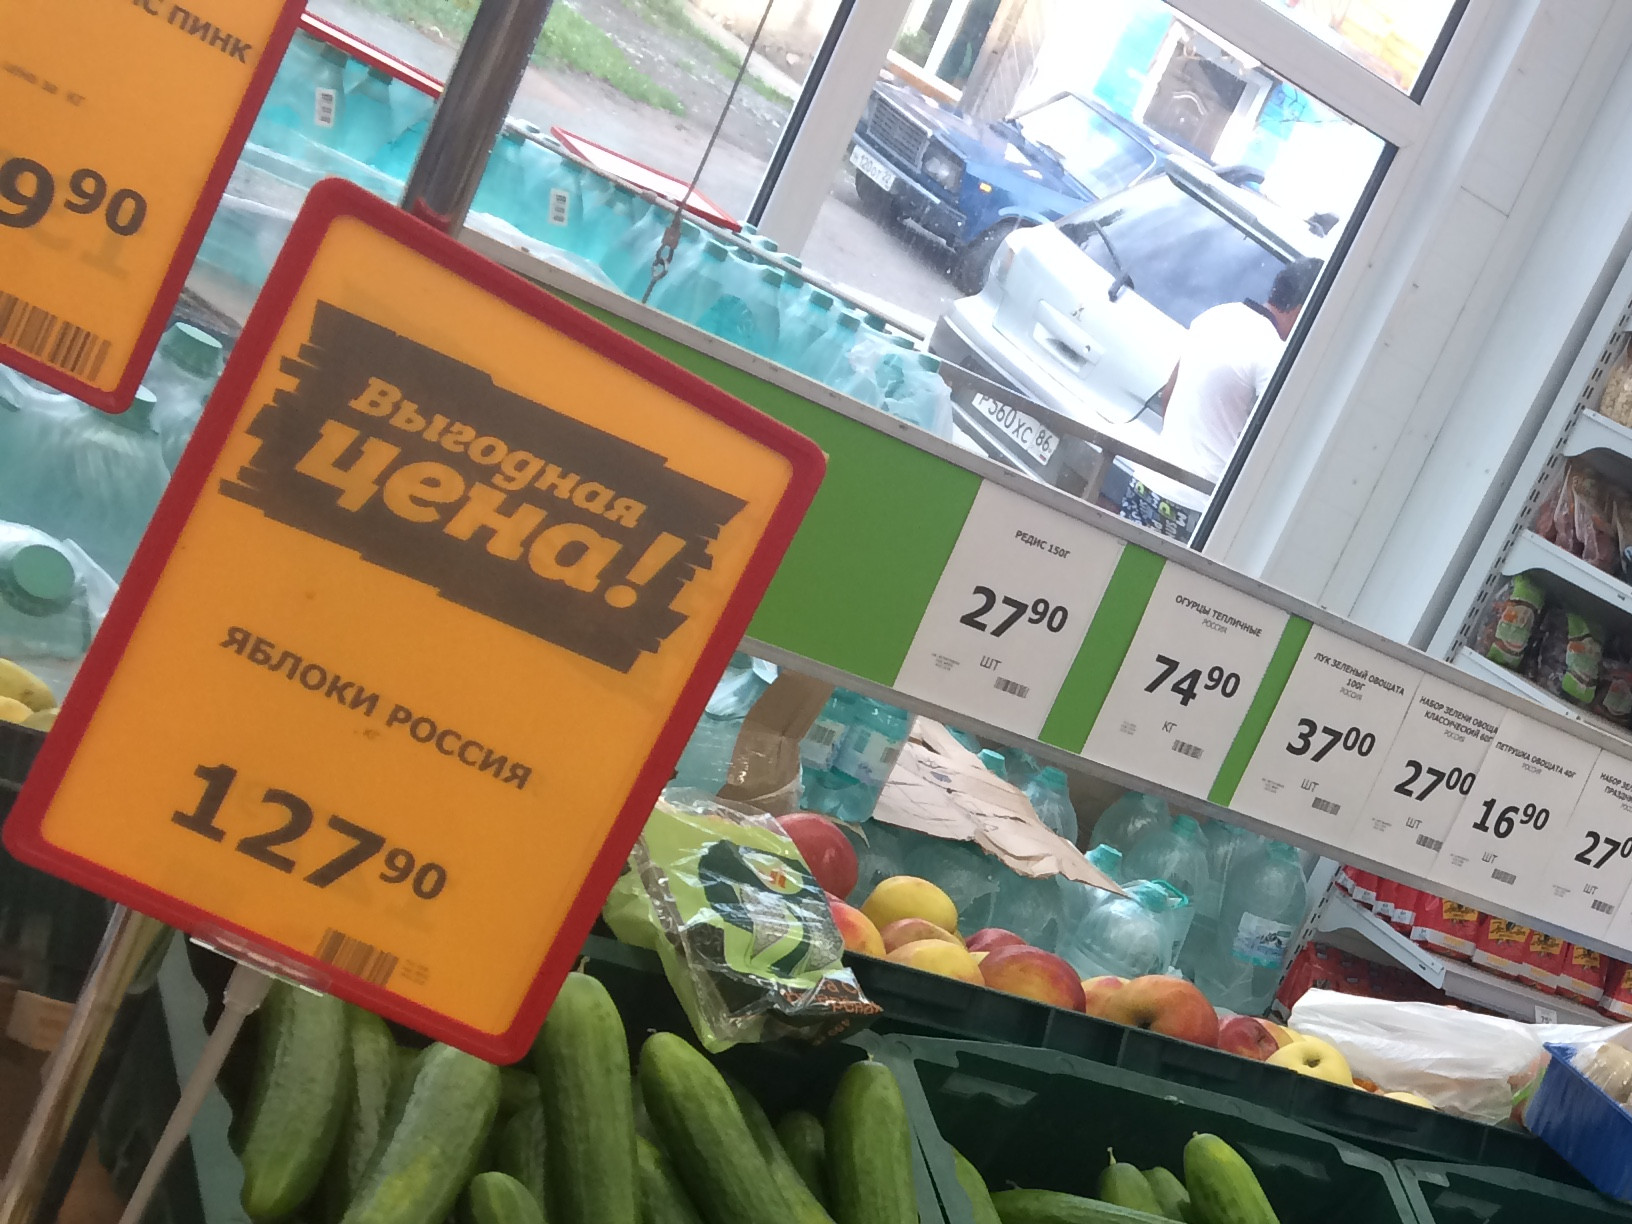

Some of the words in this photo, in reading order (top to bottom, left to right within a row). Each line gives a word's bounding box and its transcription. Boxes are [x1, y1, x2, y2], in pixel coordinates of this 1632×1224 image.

[167, 4, 252, 64] ПИНК
[348, 376, 648, 528] Выгодная
[1015, 529, 1048, 550] РЕДИС
[1047, 544, 1071, 559] 150Г
[1175, 594, 1212, 616] ОГУРЦЫ
[1211, 609, 1263, 637] ТЕПЛИЧНЫЕ
[980, 654, 1002, 671] ШТ
[1313, 652, 1332, 665] ЛУК
[1330, 658, 1369, 680] ЗЕЛЕНЫЙ
[219, 625, 381, 718] ЯБЛОКИ
[385, 703, 533, 790] РОССИЯ
